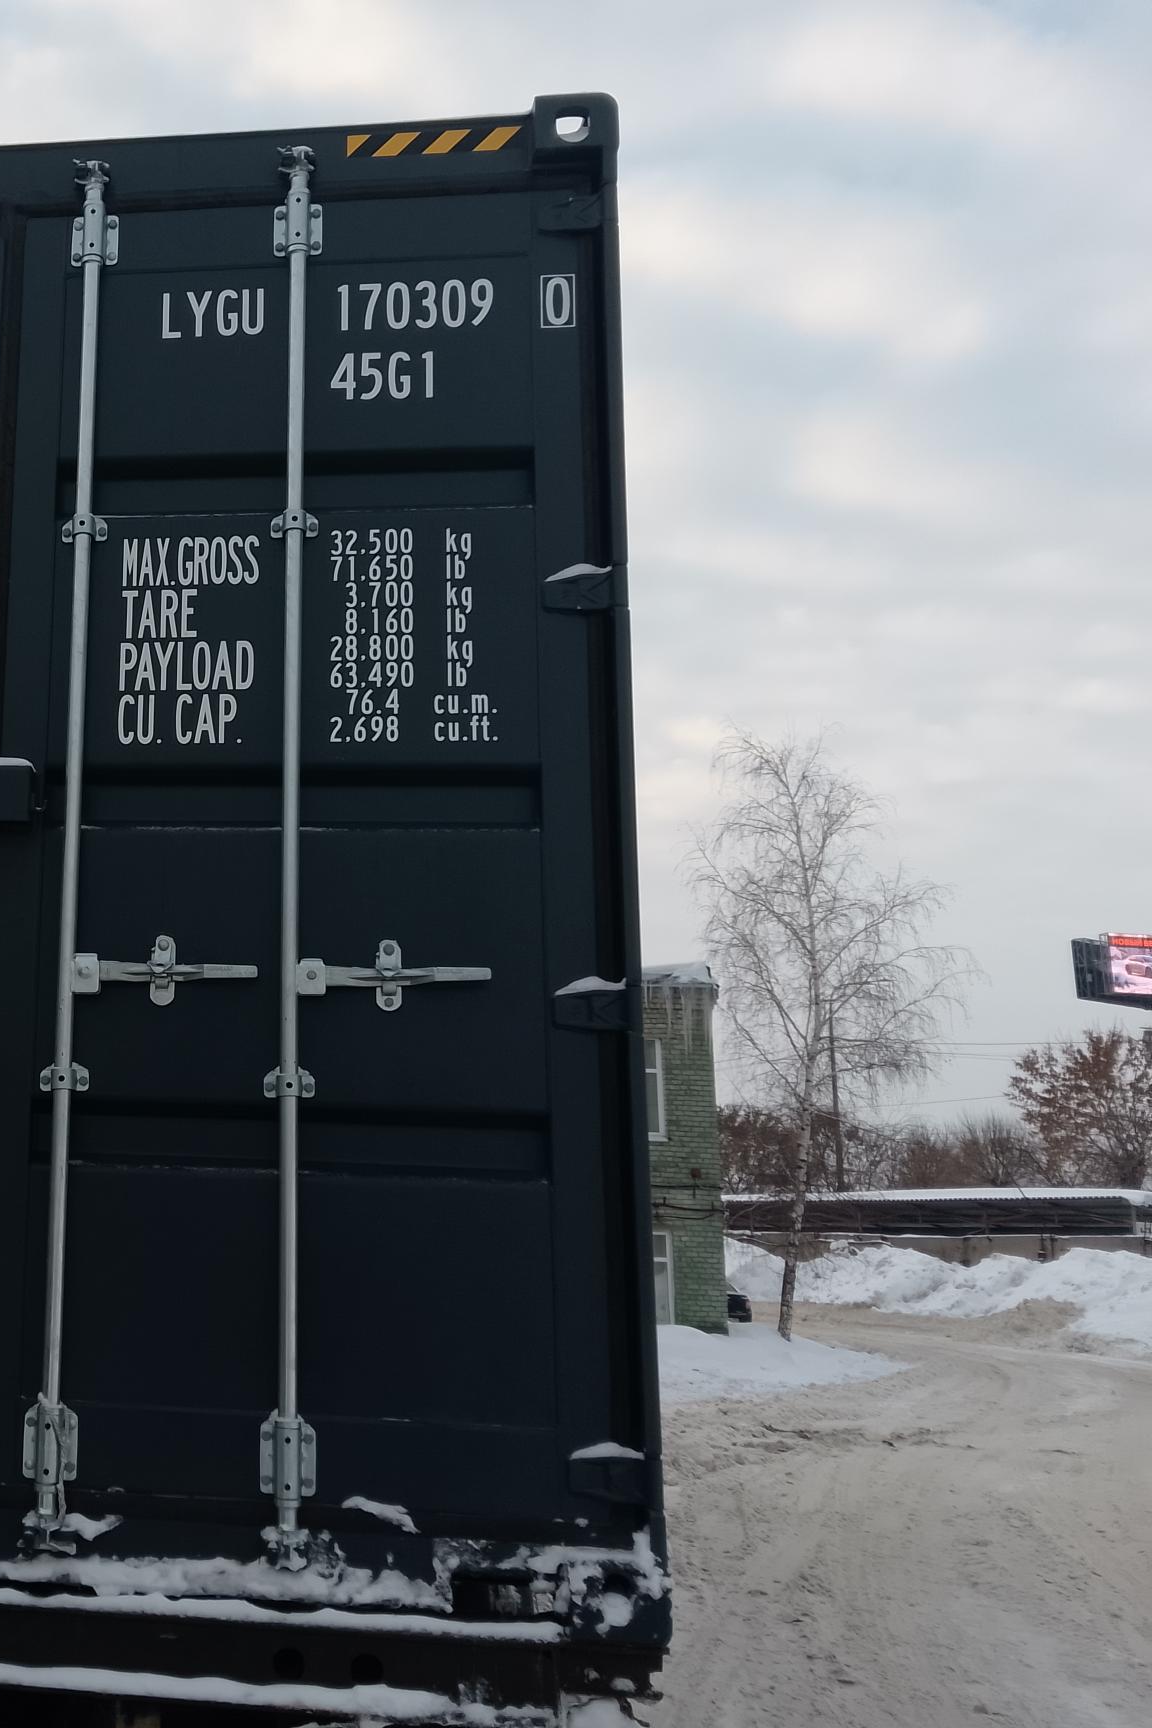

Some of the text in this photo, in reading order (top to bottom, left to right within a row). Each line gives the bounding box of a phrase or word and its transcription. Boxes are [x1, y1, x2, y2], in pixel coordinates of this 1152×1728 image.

[161, 276, 572, 340] LYGU 170309 0
[330, 350, 434, 401] 45G1
[330, 527, 472, 561] 32,500 kg
[330, 553, 466, 582] 71,650 lb
[121, 588, 198, 639] TARE
[345, 580, 473, 614] 3,700 kg
[345, 607, 467, 635] 8,160 lb
[118, 640, 255, 692] PAYLOAD
[330, 634, 473, 668] 28,800 kg
[330, 660, 467, 689] 63,490 lb
[345, 688, 498, 715] 76.4 cu.m.
[117, 693, 242, 745] CU. CAP.
[329, 714, 499, 743] 2,698 cu.ft.
